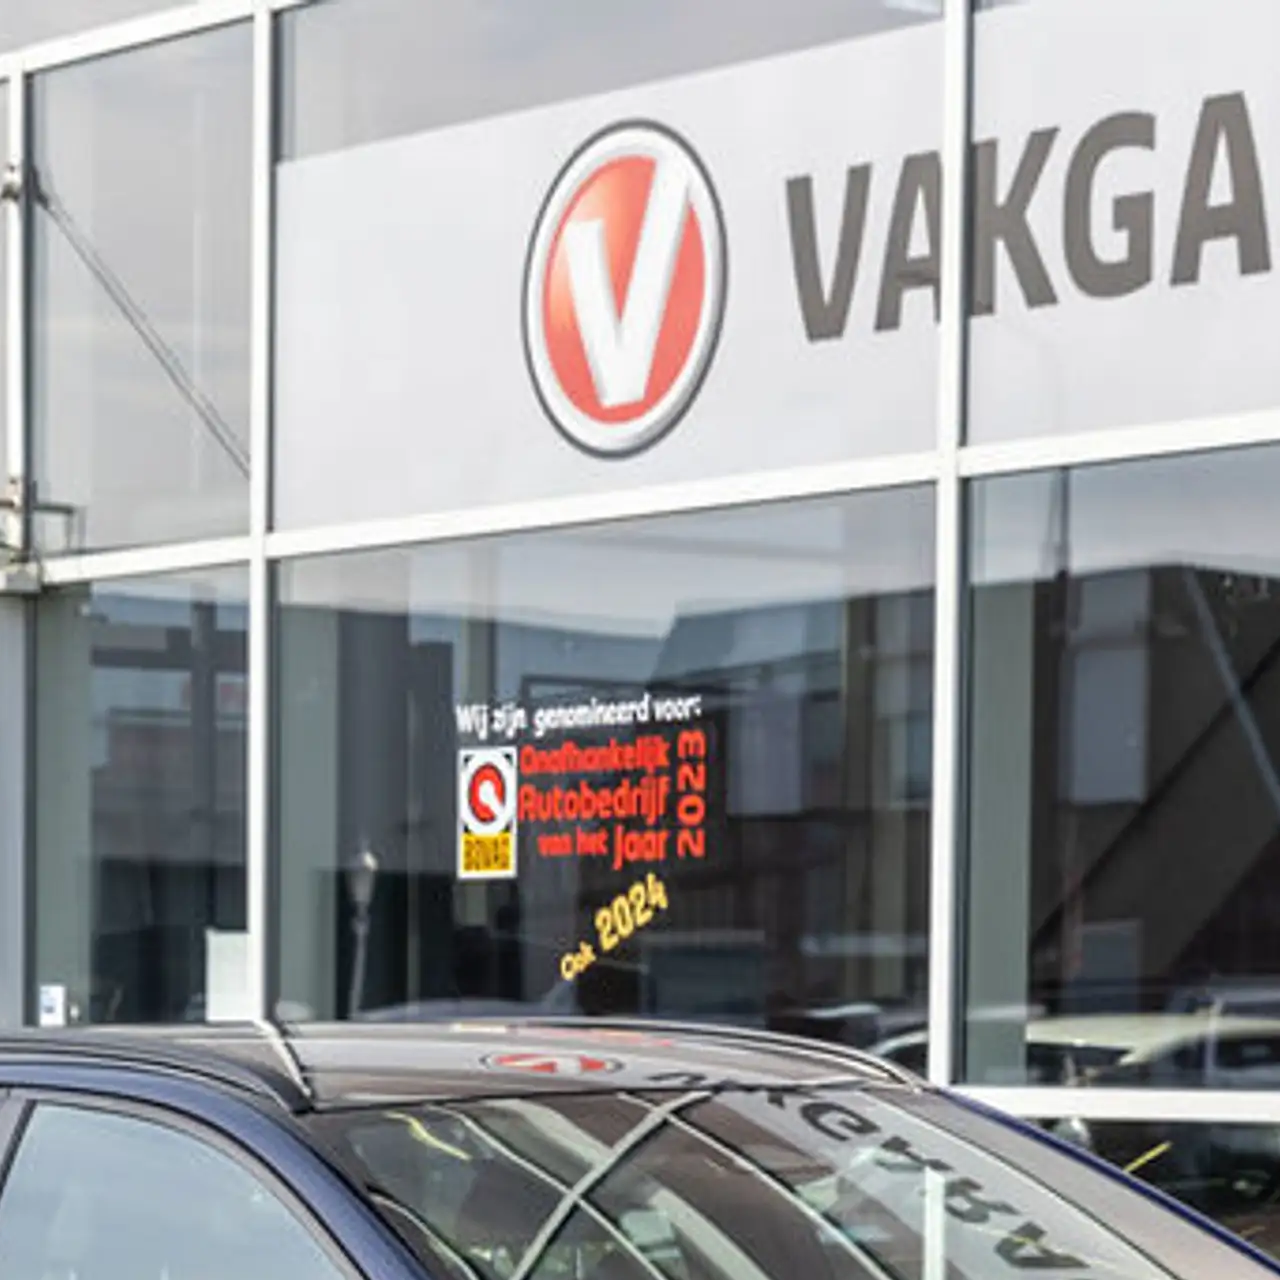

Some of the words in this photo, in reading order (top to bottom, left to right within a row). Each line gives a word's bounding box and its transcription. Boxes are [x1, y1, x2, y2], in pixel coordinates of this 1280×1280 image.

[456, 703, 488, 740] Wij
[493, 703, 528, 738] zijn
[534, 692, 652, 738] genomineerd
[520, 736, 670, 776] Onafhankelijk
[518, 776, 670, 826] Autobedrijf
[676, 729, 706, 858] 2023
[537, 833, 572, 856] van
[576, 826, 608, 856] het
[595, 872, 668, 951] 2024
